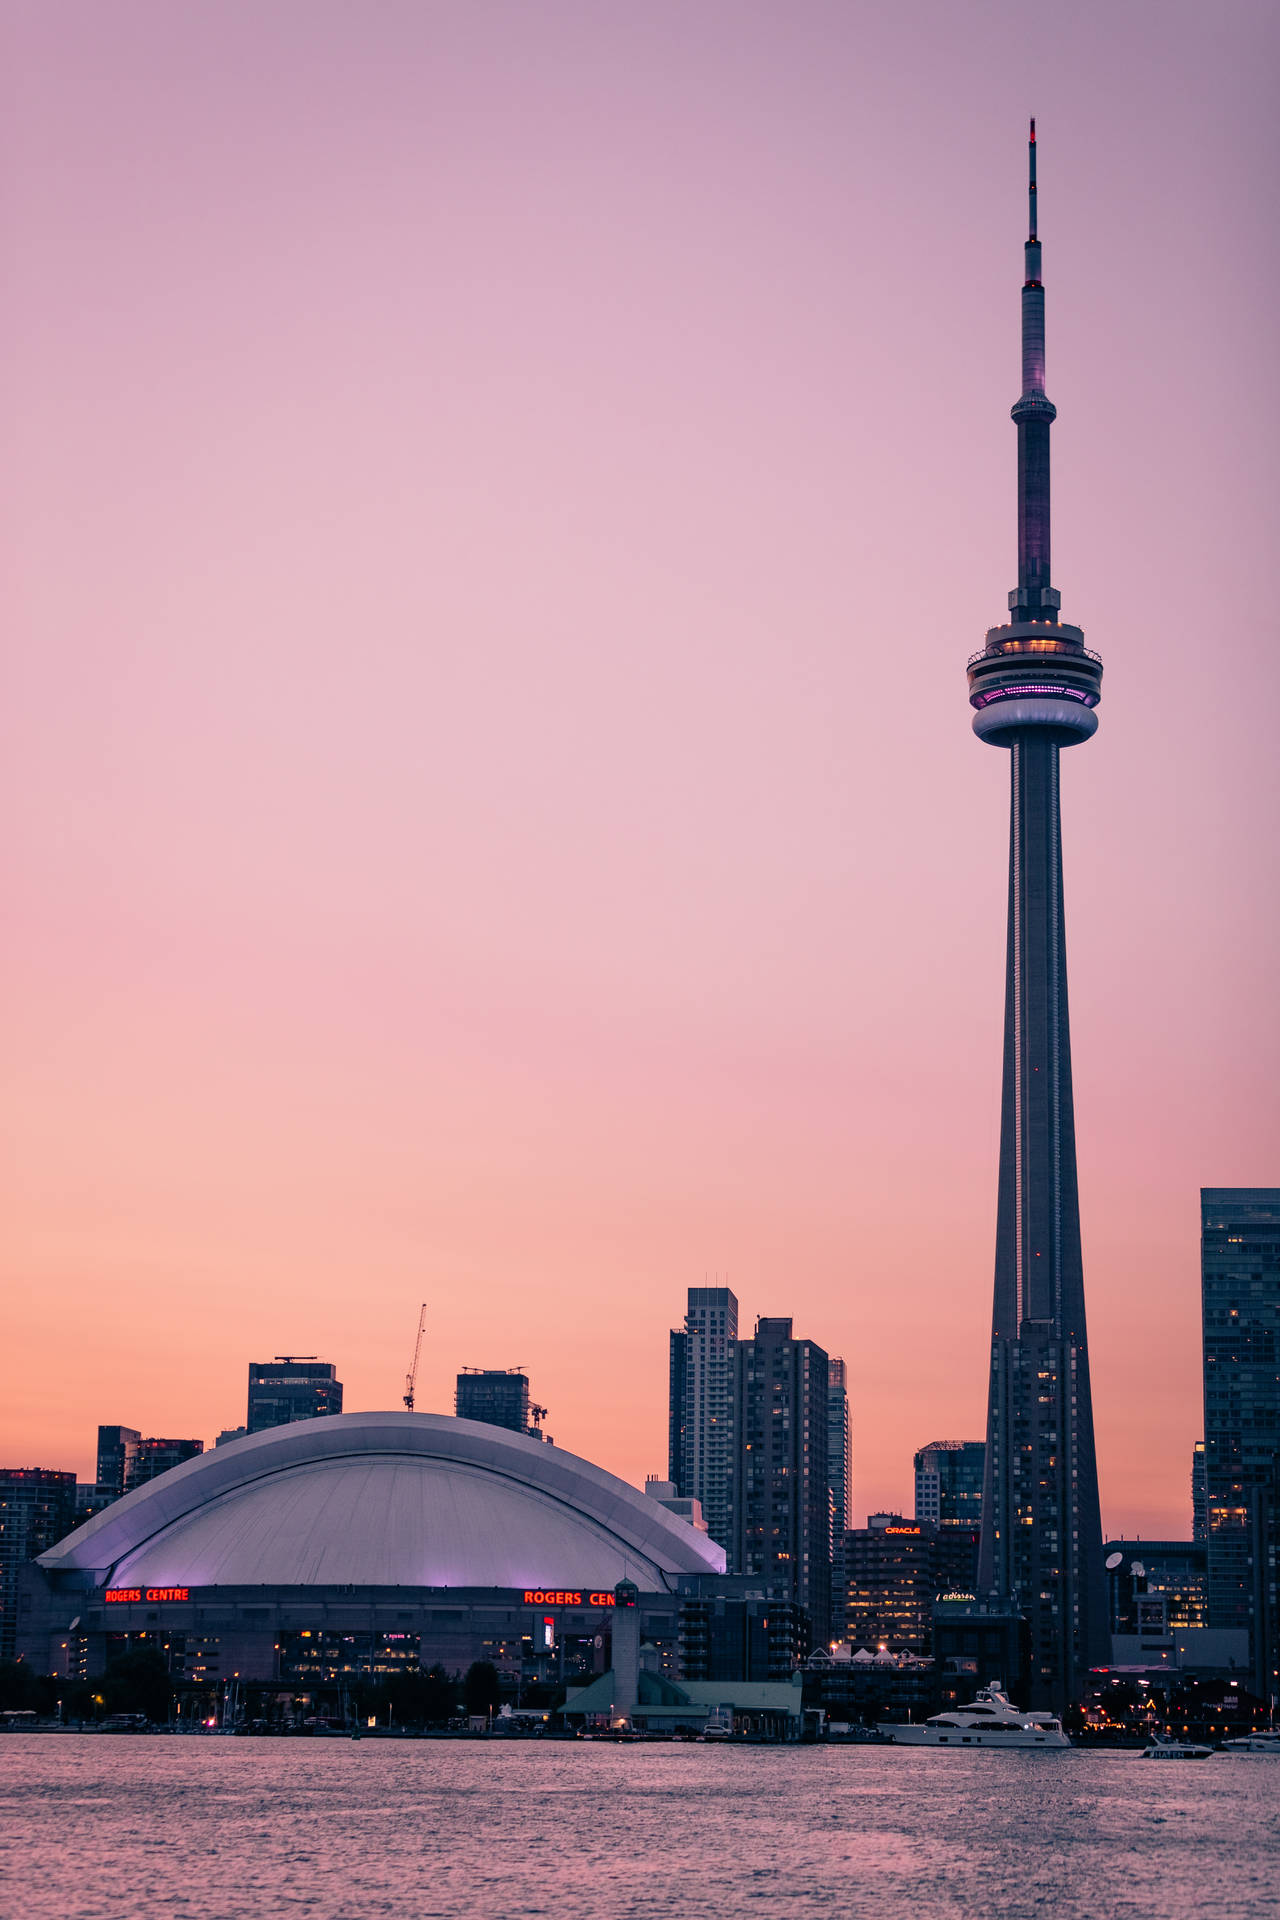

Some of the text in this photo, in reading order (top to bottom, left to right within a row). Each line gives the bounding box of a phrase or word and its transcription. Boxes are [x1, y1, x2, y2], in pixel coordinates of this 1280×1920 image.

[105, 1588, 190, 1602] ROGERS CENTRE
[524, 1591, 582, 1605] ROGERS
